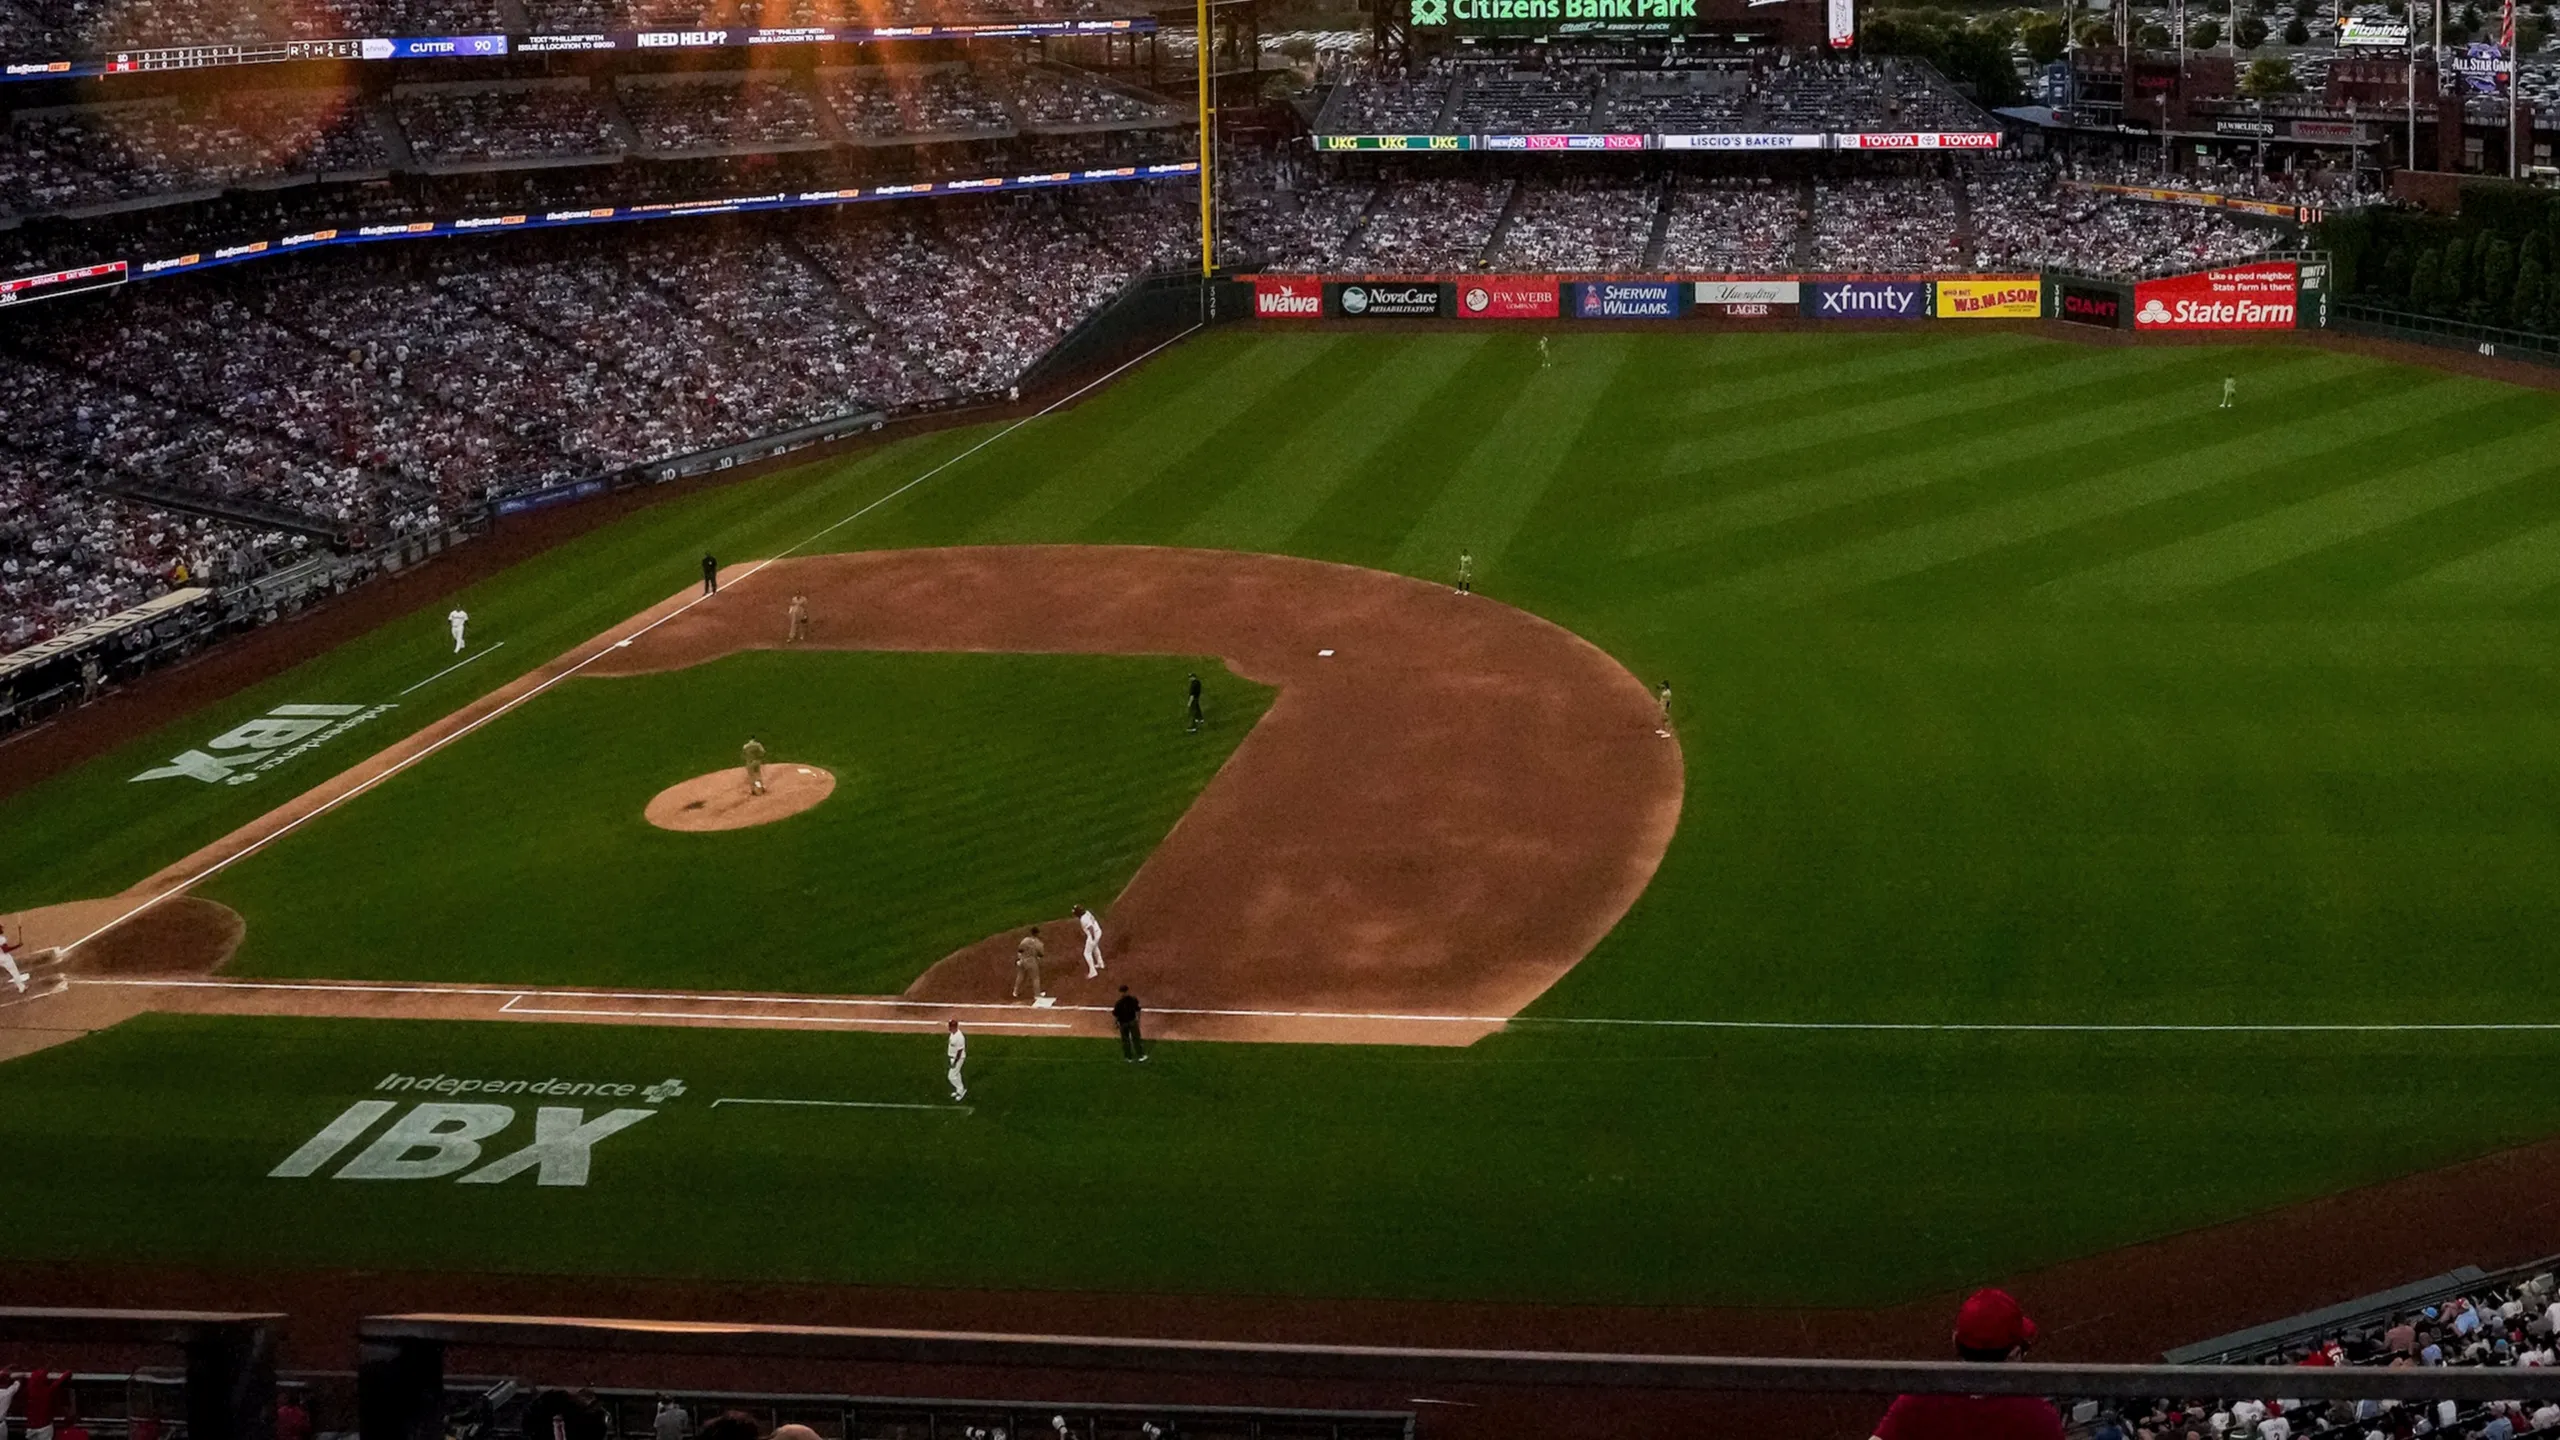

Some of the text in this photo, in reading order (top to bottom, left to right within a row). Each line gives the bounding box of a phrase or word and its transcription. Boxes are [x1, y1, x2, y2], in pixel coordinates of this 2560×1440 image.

[1453, 0, 1697, 19] Citizens Bank Park
[2344, 17, 2409, 37] Fitzpatrick
[637, 32, 728, 47] NEED HELP?
[291, 45, 346, 55] R H E
[410, 40, 491, 53] CUTTER 90
[546, 42, 581, 50] LOCATION
[7, 63, 48, 75] theScore
[2452, 57, 2515, 72] ALL STAR GAM
[1328, 137, 1357, 148] UKG
[1379, 137, 1408, 148] UKG
[1429, 137, 1458, 148] UKG
[1530, 137, 1564, 148] NECA
[1608, 137, 1642, 147] NECA
[1690, 136, 1794, 146] LISCIO'S BAKERY
[1864, 135, 1915, 146] TOYOTA
[1943, 134, 1993, 145] TOYOTA
[546, 210, 590, 221] theScore
[455, 217, 500, 228] theScore
[359, 225, 407, 236] theScore
[282, 233, 314, 245] theScore
[215, 245, 249, 258] theScore
[143, 258, 180, 272] theScore
[2208, 272, 2226, 281] Like
[2235, 272, 2254, 282] good
[1604, 285, 1667, 300] SHERWIN
[1715, 285, 1780, 300] Yuengling
[2213, 283, 2235, 292] State
[2238, 283, 2259, 291] Farm
[2261, 283, 2268, 291] is
[1369, 288, 1437, 304] NovaCare
[1517, 292, 1552, 302] WEBB
[1823, 284, 1914, 313] xfinity
[1258, 294, 1319, 313] Wawa
[1726, 304, 1768, 315] LAGER
[2064, 296, 2118, 317] GIANT
[2479, 343, 2494, 356] 401
[774, 445, 786, 455] 10
[720, 457, 733, 469] 10
[661, 468, 676, 481] 10
[128, 704, 366, 783] IBX
[375, 1073, 636, 1097] Independence
[267, 1100, 658, 1186] IBX
